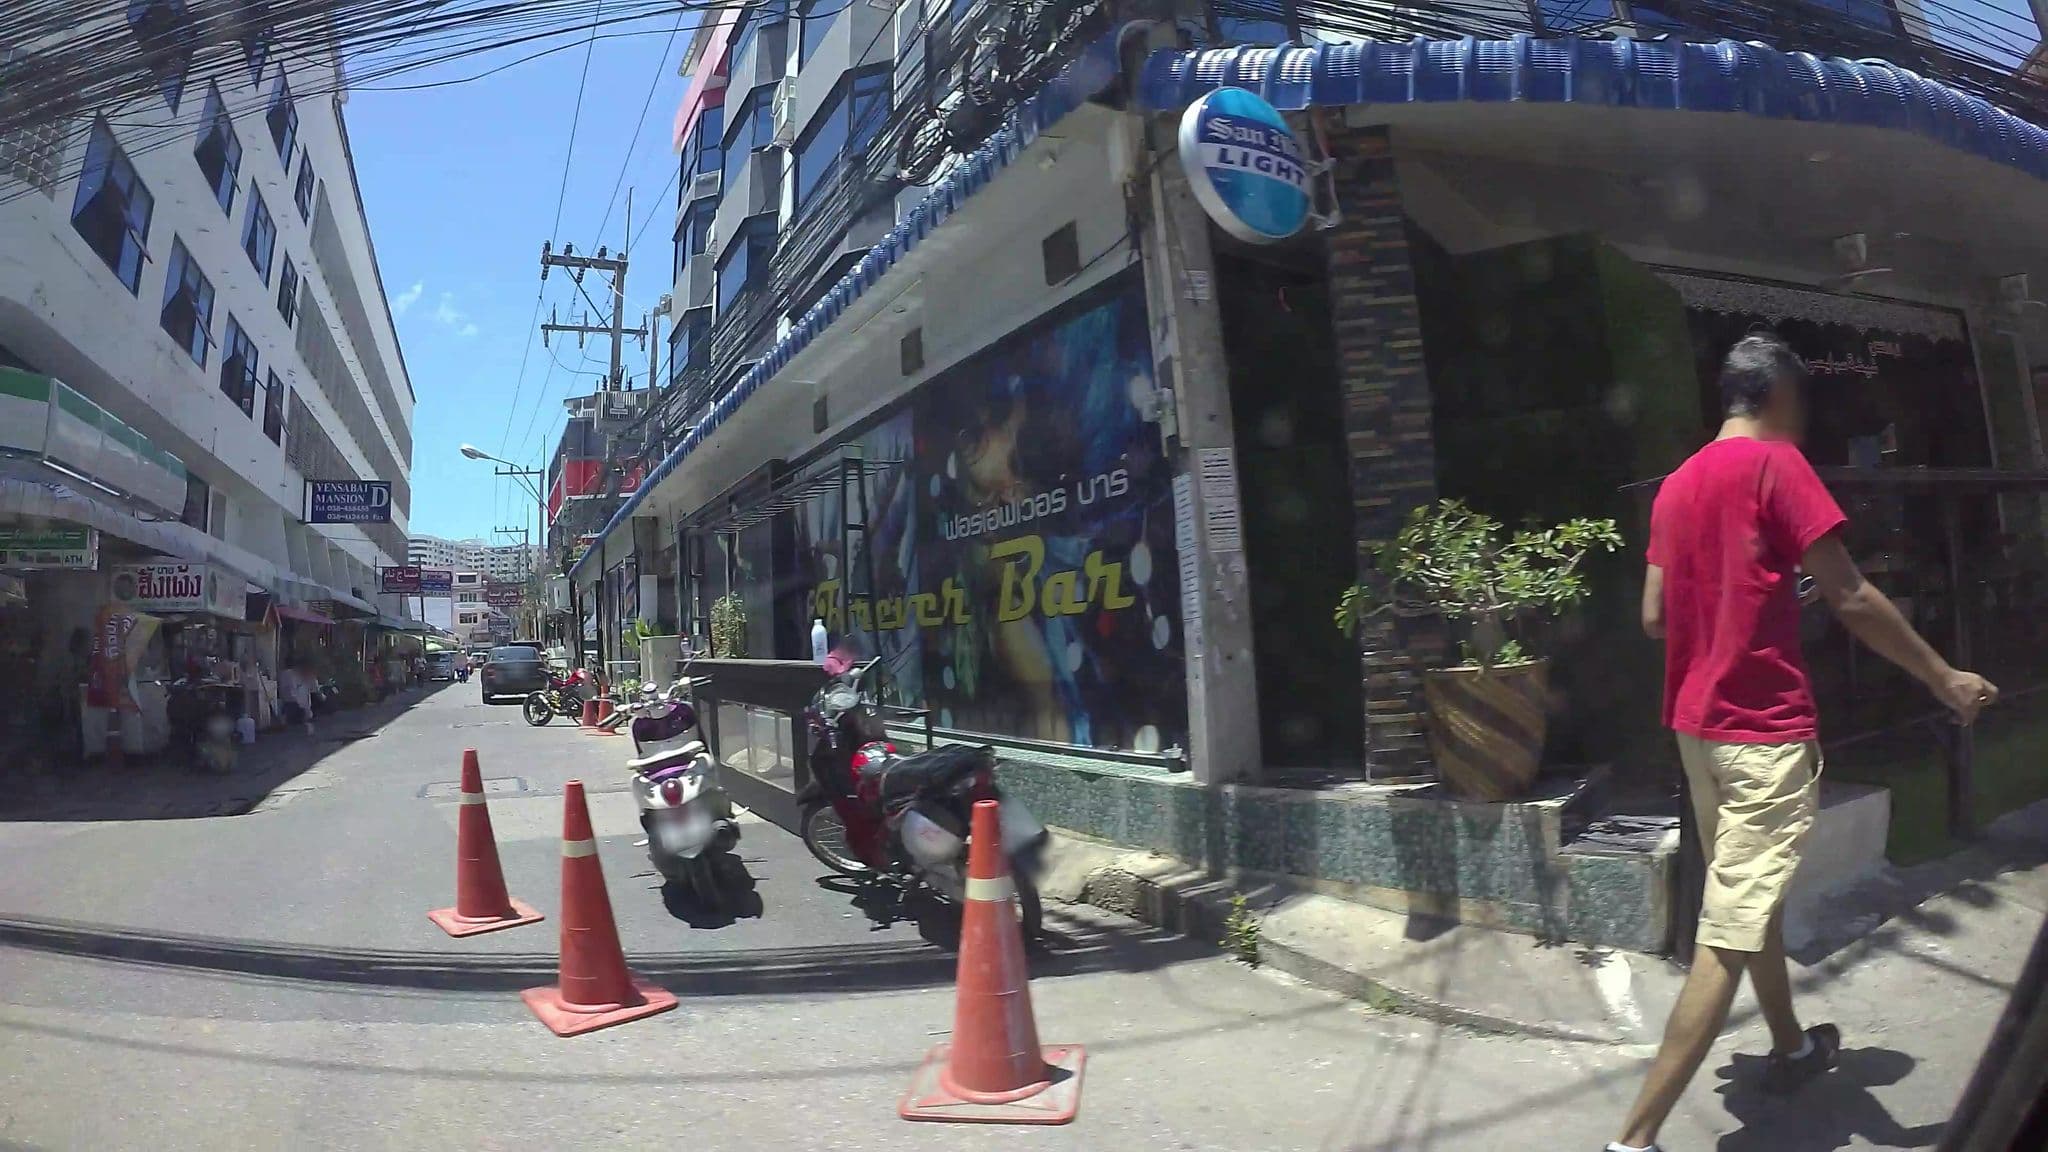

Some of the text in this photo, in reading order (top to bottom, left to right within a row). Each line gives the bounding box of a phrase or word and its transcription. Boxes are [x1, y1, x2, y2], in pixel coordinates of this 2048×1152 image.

[1206, 117, 1267, 146] San
[1218, 147, 1304, 185] LIGHT
[316, 482, 369, 493] YENSABAI
[1077, 453, 1129, 505] บาร์
[315, 494, 365, 504] MANSION
[370, 485, 389, 508] D
[814, 577, 973, 632] Frever
[989, 534, 1135, 623] Bar
